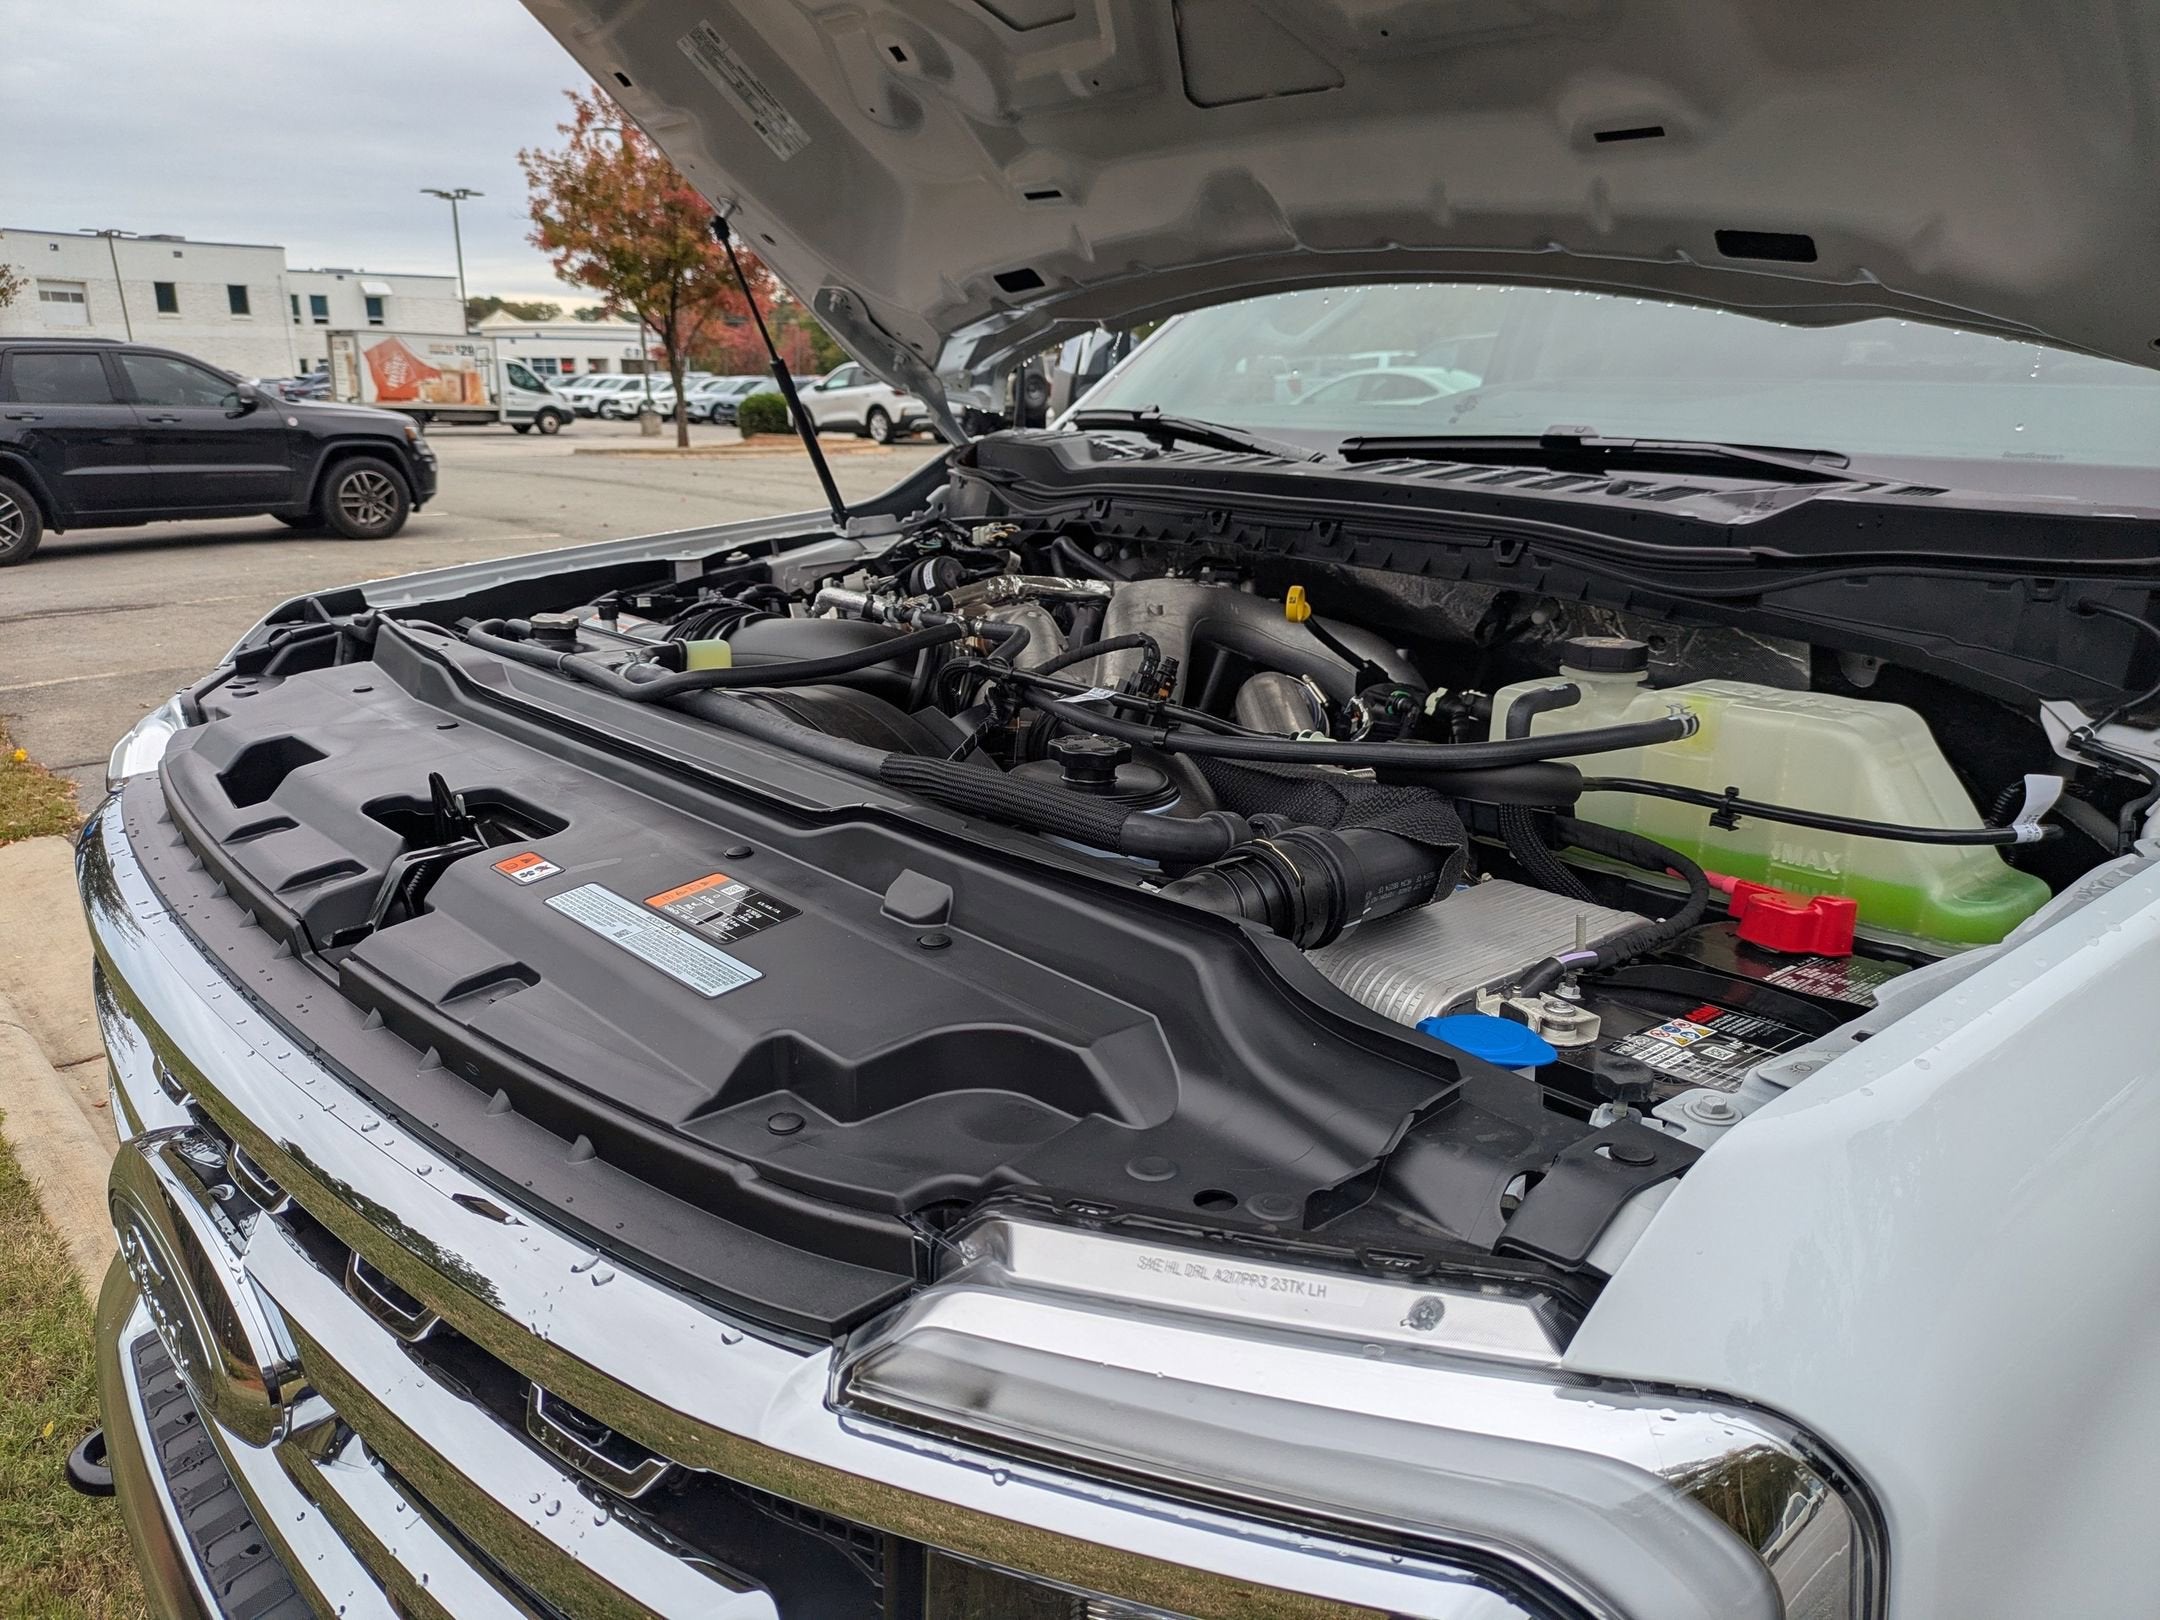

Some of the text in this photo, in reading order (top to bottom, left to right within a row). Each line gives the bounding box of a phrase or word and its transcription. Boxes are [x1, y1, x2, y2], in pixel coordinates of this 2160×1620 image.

[1137, 1256, 1164, 1273] SAE
[1184, 1262, 1211, 1280] DRL
[1270, 1276, 1305, 1295] 23TK
[1308, 1284, 1328, 1298] LH
